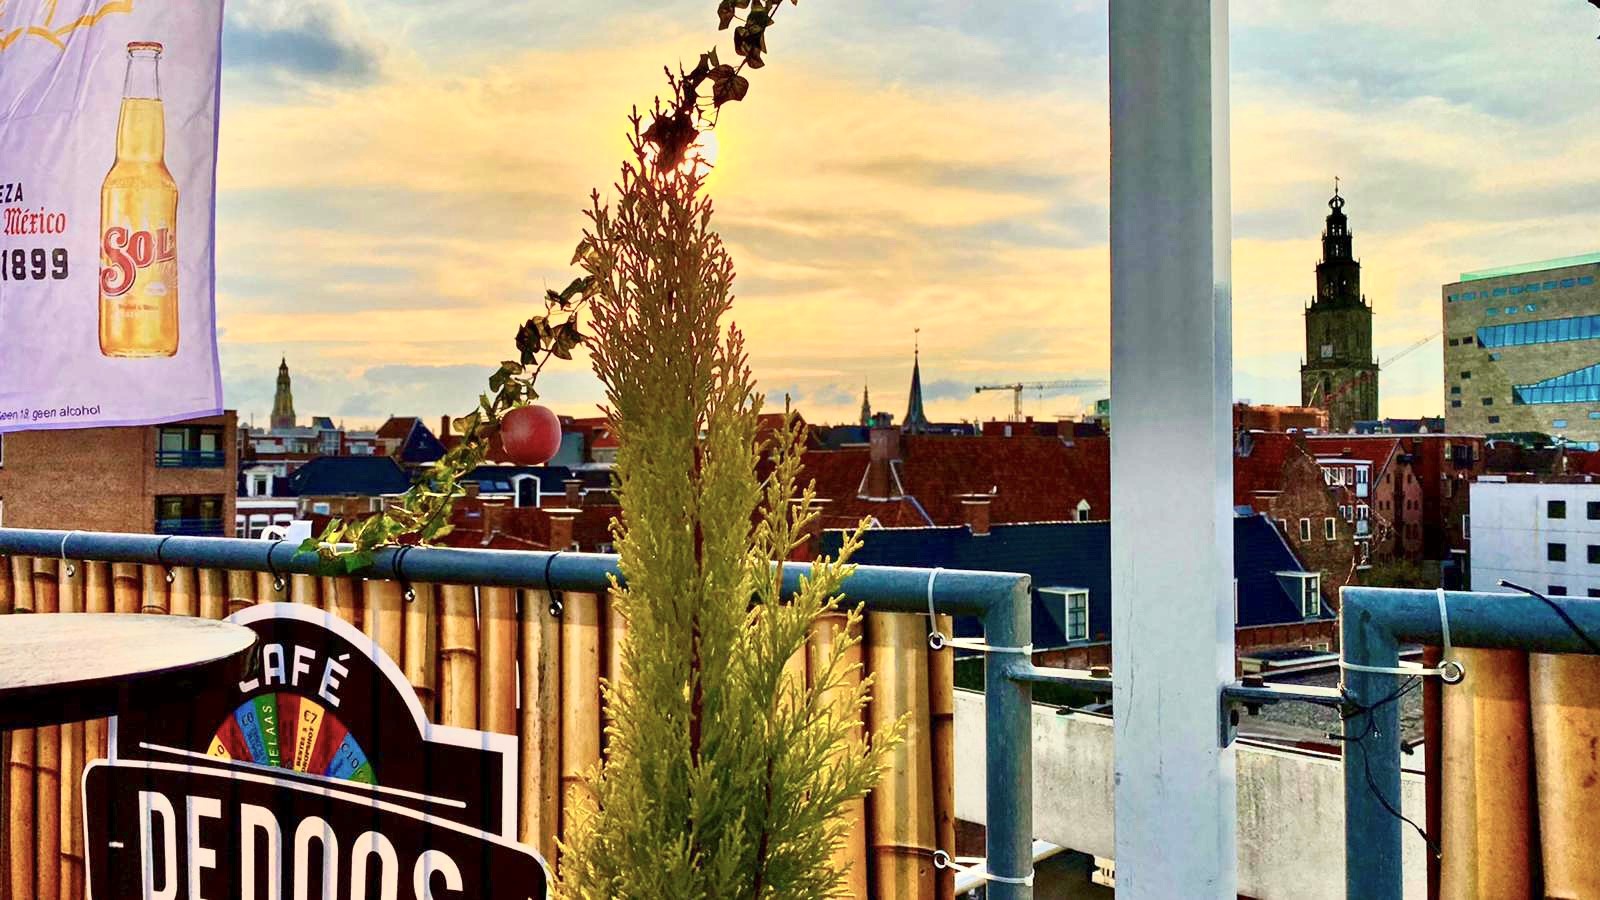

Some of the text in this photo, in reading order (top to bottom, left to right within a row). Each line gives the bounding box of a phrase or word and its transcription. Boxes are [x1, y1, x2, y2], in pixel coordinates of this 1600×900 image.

[4, 206, 66, 235] México
[2, 248, 68, 281] 1899
[0, 410, 17, 420] een
[32, 408, 57, 421] geen
[59, 404, 101, 417] alcohol
[138, 791, 221, 900] DE
